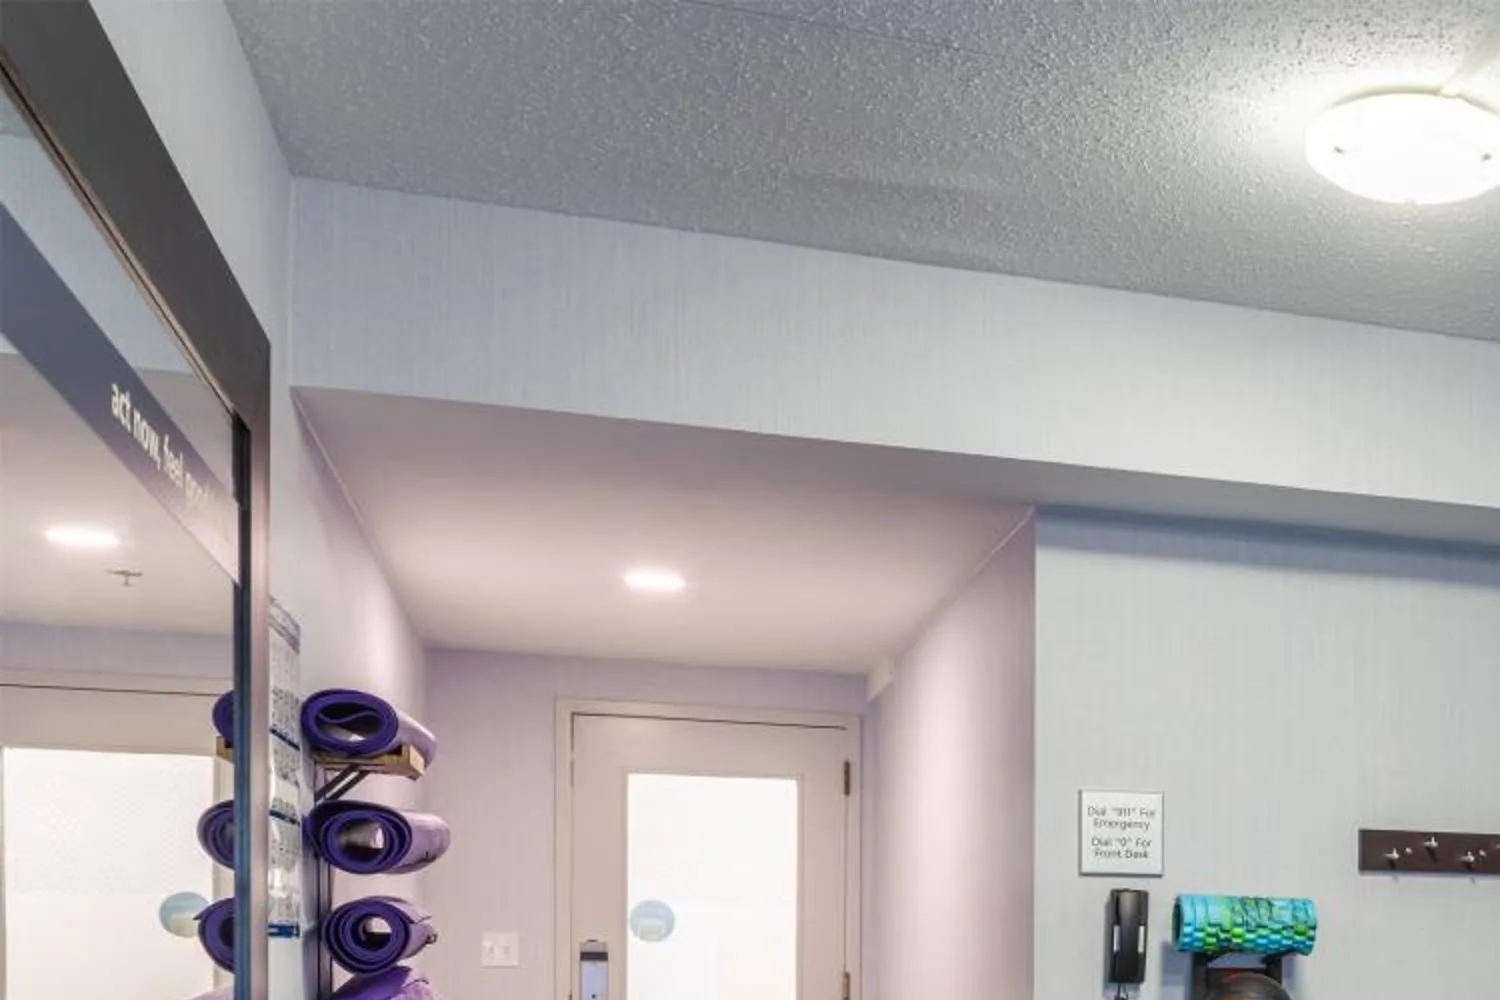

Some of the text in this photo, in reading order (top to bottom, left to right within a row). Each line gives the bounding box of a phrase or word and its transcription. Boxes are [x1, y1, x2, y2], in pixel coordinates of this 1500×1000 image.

[111, 383, 131, 433] act
[1087, 806, 1107, 817] Dial
[1093, 818, 1151, 831] Emergency
[1091, 837, 1113, 847] Dial
[1135, 838, 1152, 847] For
[1094, 848, 1148, 859] Front Desk
